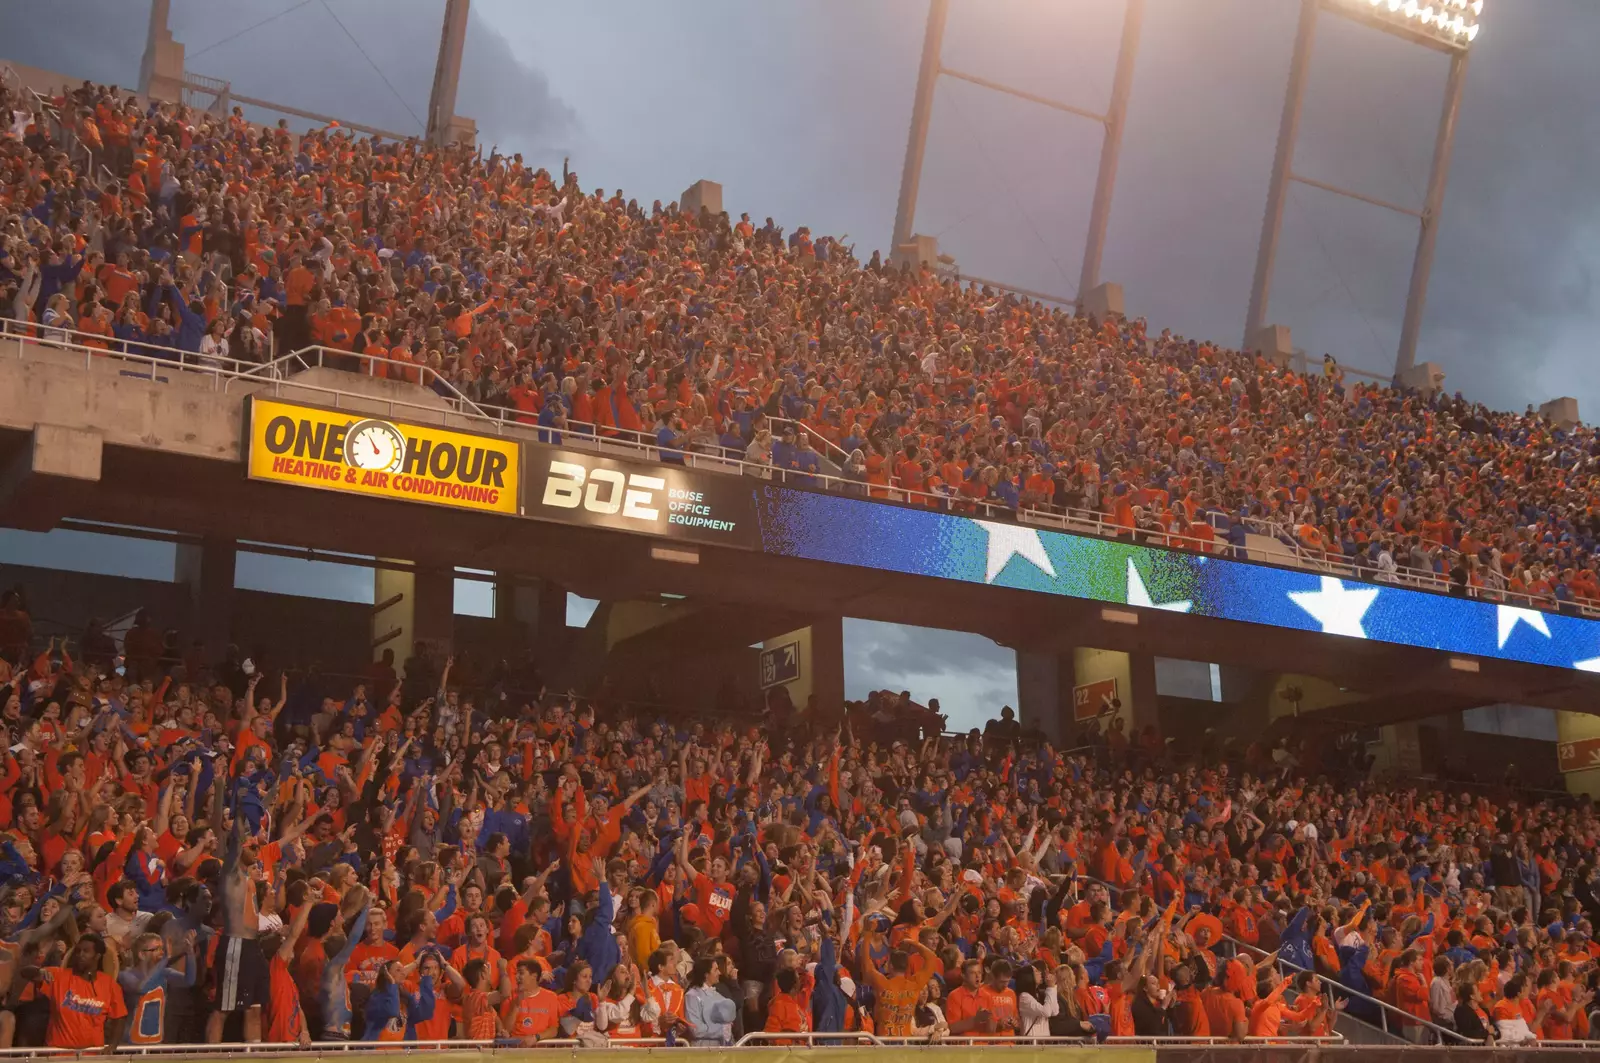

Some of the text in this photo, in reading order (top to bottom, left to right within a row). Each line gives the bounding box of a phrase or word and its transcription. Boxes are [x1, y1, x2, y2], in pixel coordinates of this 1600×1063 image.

[265, 415, 508, 488] ONE HOUR
[272, 456, 499, 504] HEATING & AIR CONDITIONING
[542, 460, 665, 521] BOE
[668, 488, 704, 502] BOISE
[668, 501, 711, 515] OFFICE
[668, 514, 736, 531] EQUIPMENT
[763, 664, 776, 684] 121
[1076, 688, 1090, 706] 22
[1561, 745, 1575, 759] 23
